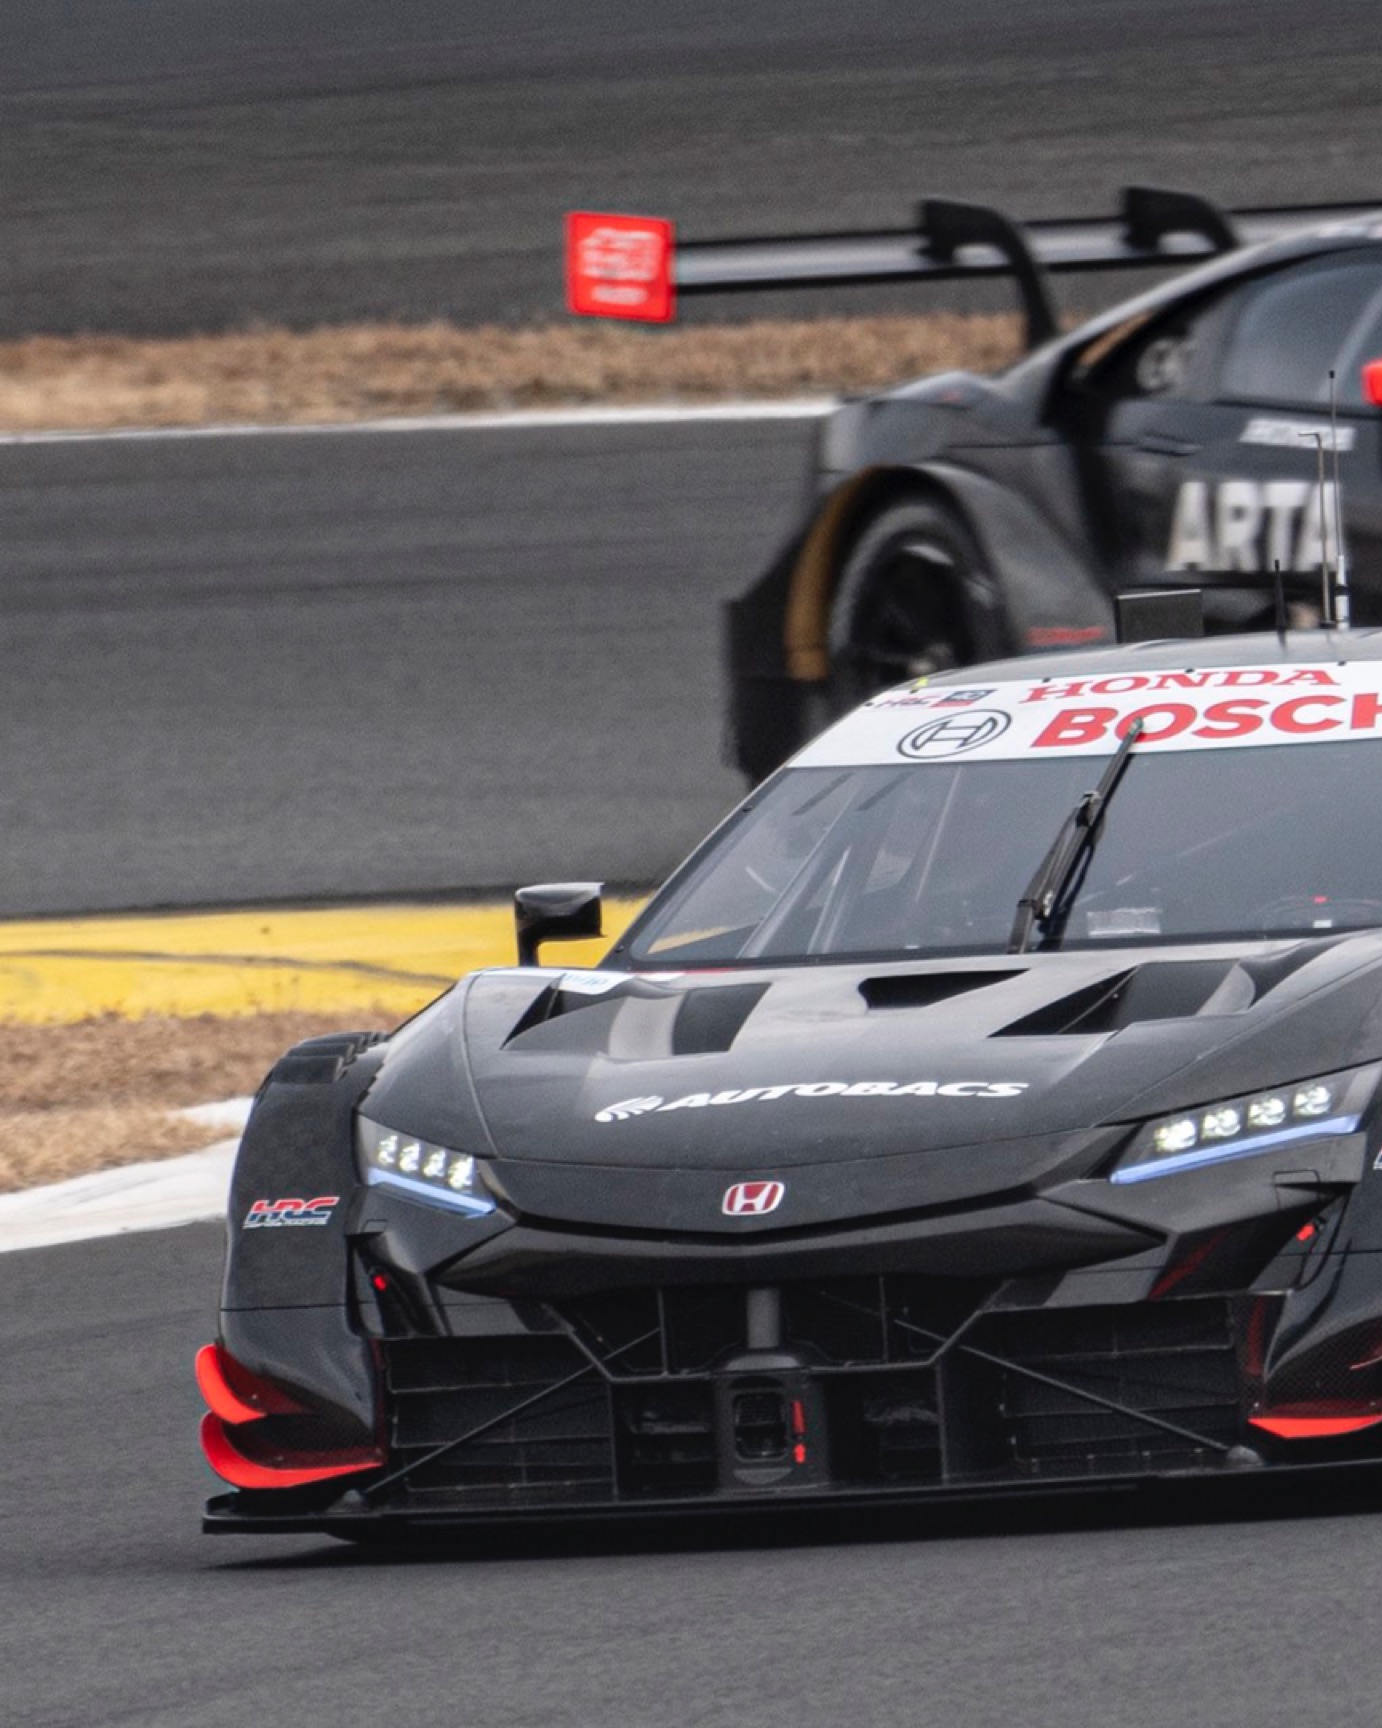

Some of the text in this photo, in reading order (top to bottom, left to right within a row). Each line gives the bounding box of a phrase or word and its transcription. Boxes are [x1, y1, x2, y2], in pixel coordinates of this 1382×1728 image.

[1165, 481, 1345, 572] ARTA
[1019, 669, 1341, 704] HONDA
[656, 1081, 1029, 1112] AUTOBACS
[244, 1196, 340, 1225] HRC
